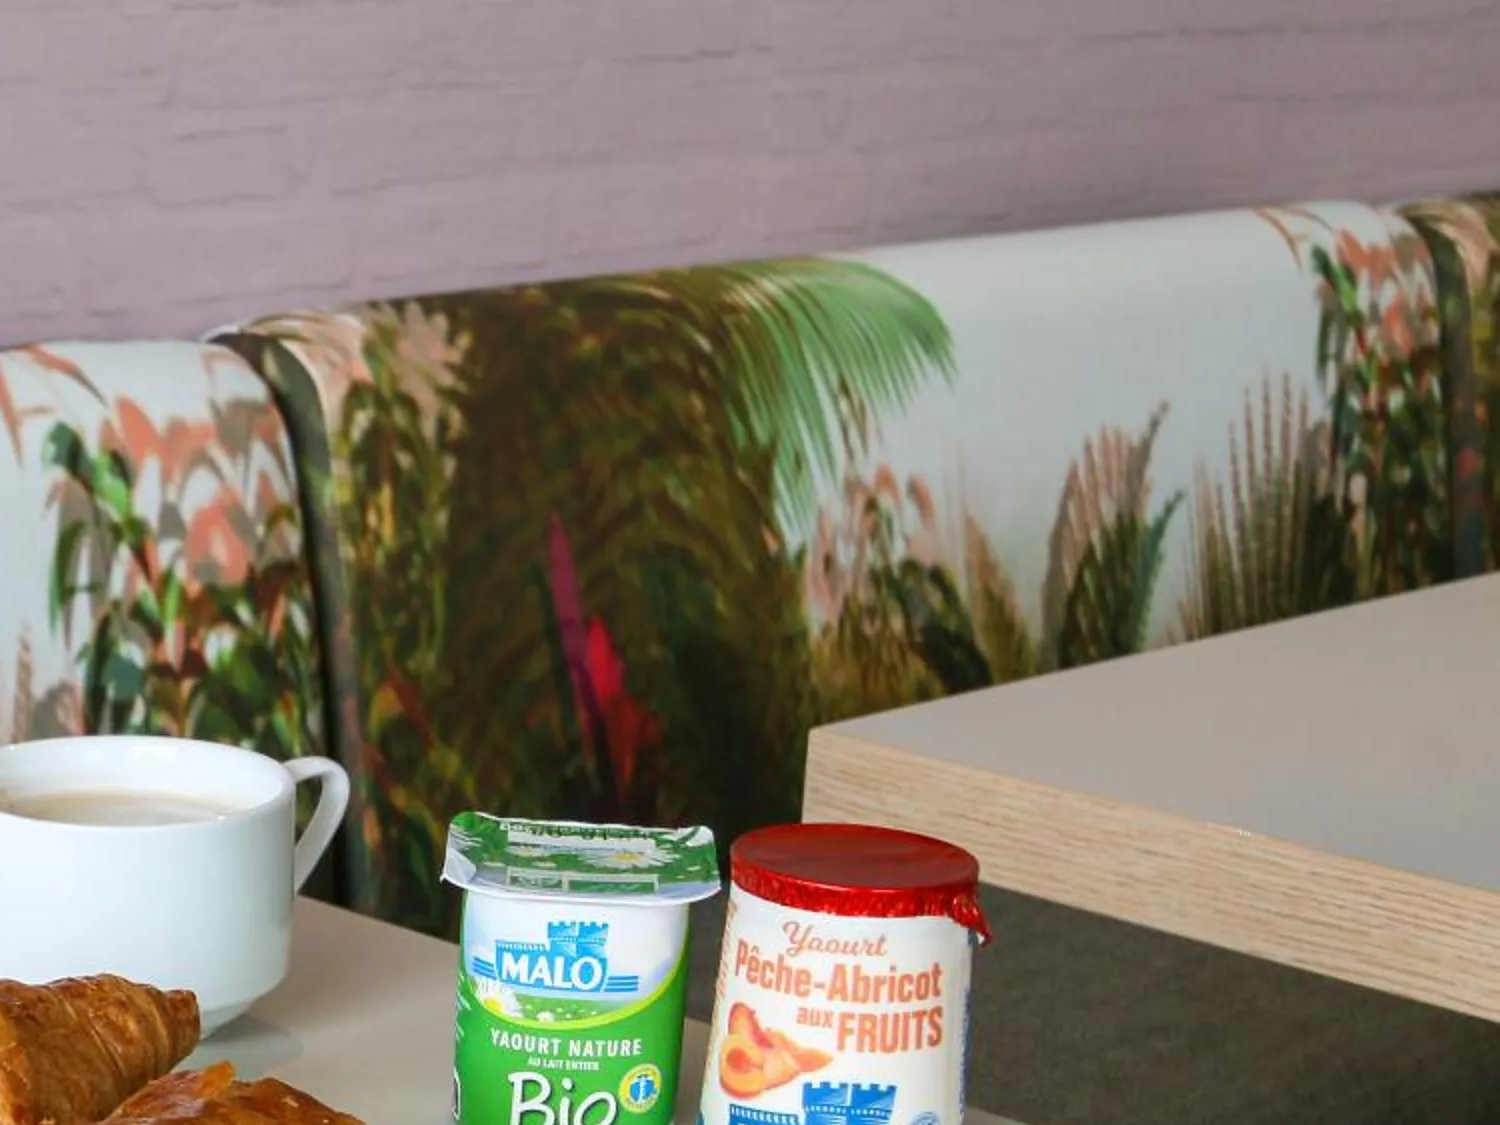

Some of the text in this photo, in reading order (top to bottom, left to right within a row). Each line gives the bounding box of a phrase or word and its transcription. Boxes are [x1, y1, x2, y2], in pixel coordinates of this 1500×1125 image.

[782, 920, 887, 957] Yaourt
[501, 952, 603, 990] MALO
[735, 938, 943, 1004] Pêche-Abricot
[491, 1028, 642, 1056] YAOURT NATURE
[796, 1005, 943, 1054] aux FRUITS
